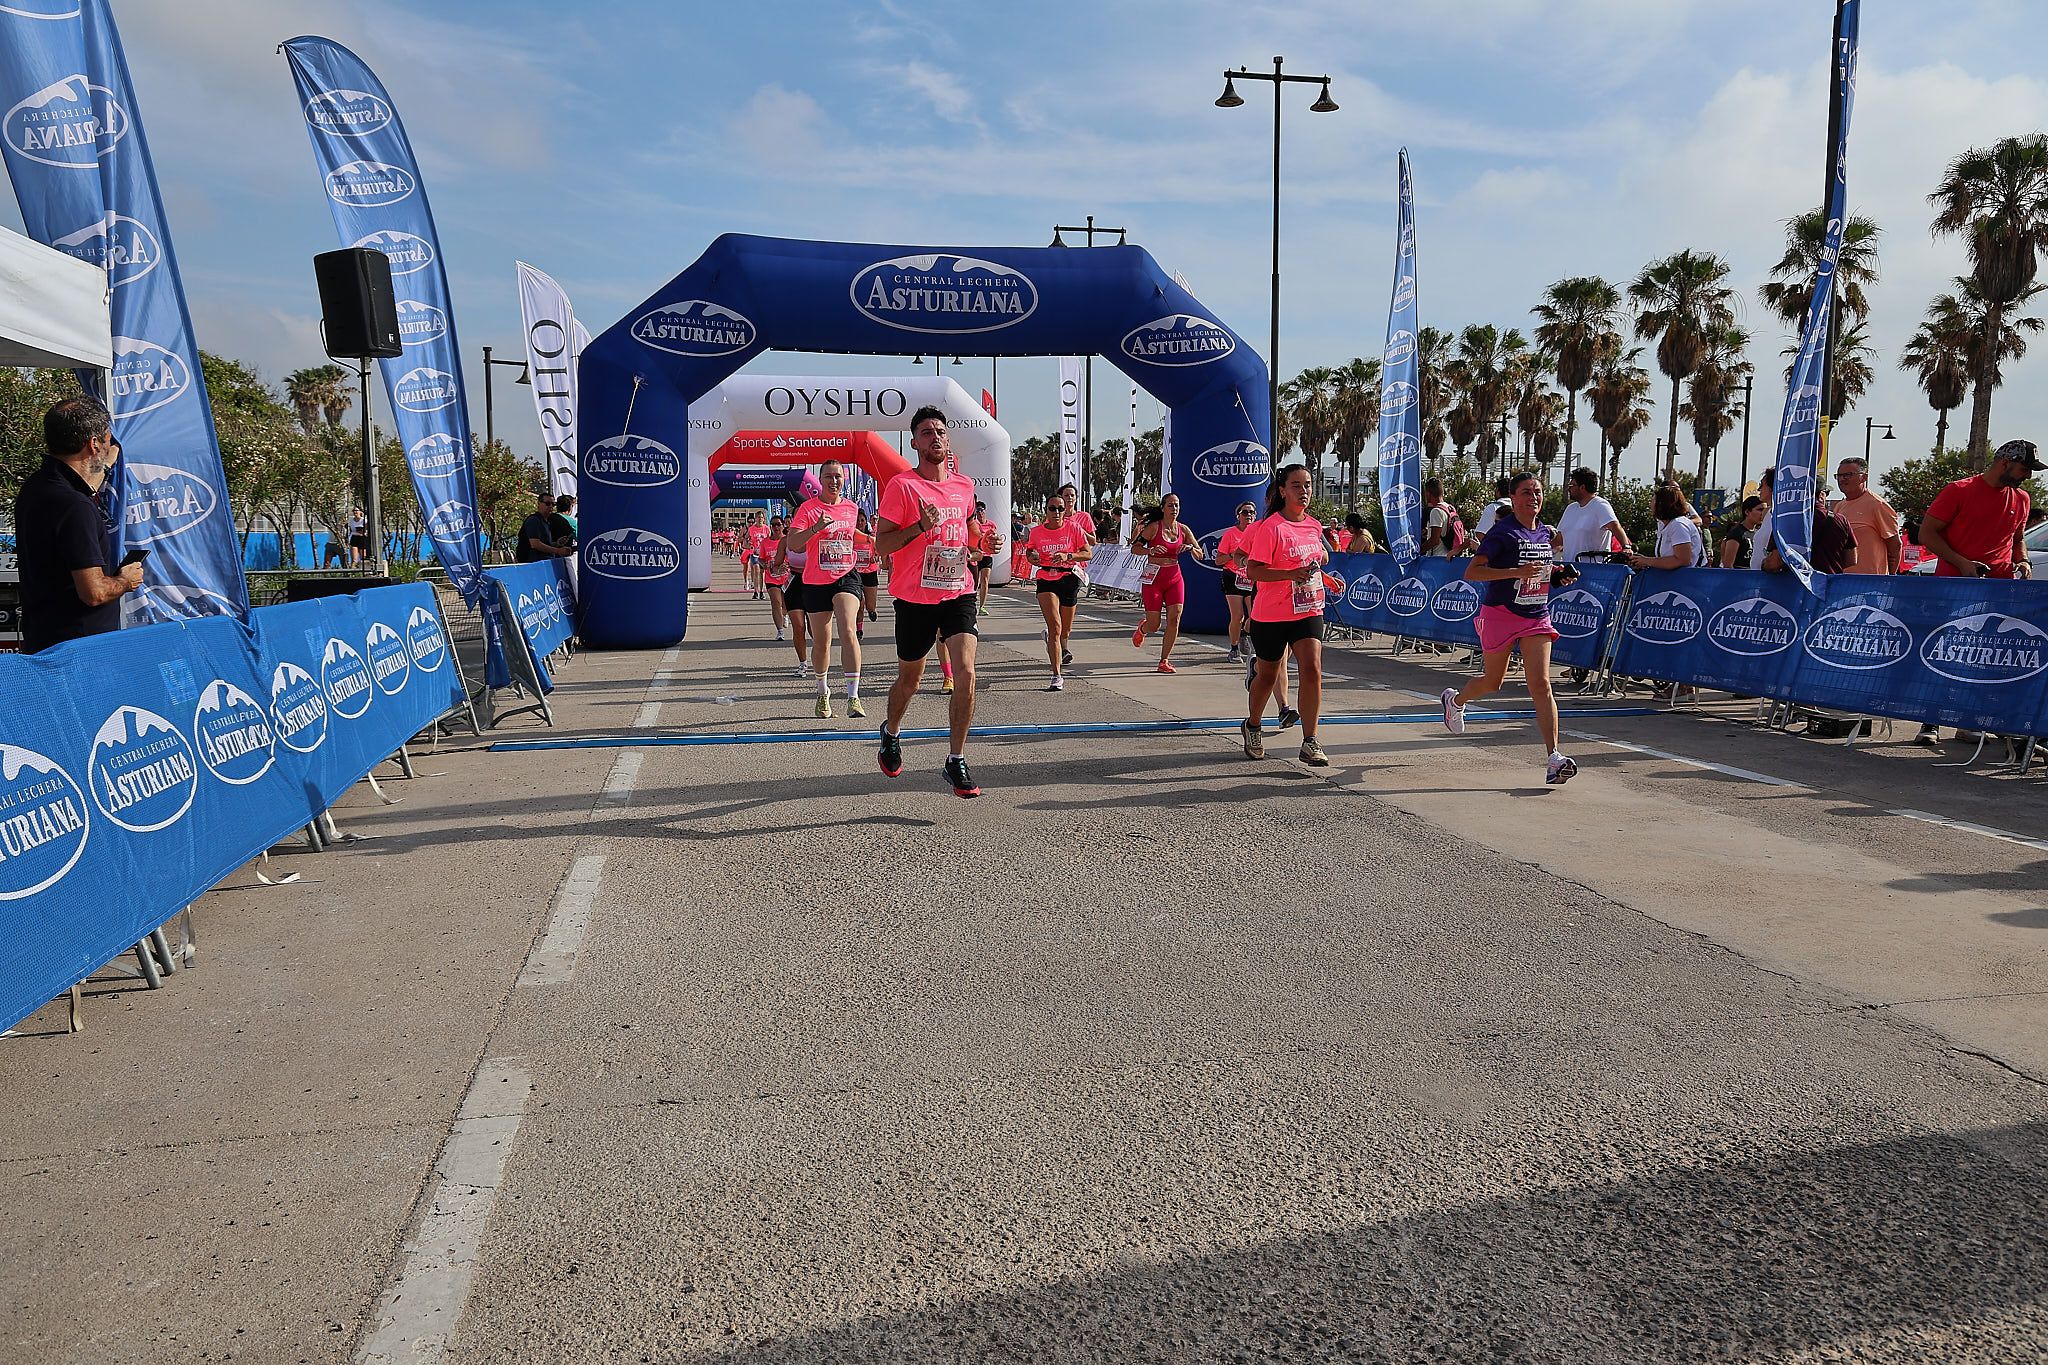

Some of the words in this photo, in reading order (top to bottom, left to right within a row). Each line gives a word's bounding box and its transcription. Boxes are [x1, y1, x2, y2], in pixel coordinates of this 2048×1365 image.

[894, 274, 953, 286] CENTRAL
[959, 277, 1018, 287] LECHERA
[864, 275, 1024, 314] ASTURIANA
[638, 318, 746, 345] ASTURIANA
[660, 317, 702, 325] CENTRAL
[705, 320, 745, 330] LECHERA
[1148, 331, 1187, 340] CENTRAL
[1190, 329, 1223, 337] LECHERA
[1130, 336, 1231, 355] ASTURIANA
[764, 387, 907, 416] OYSHO
[688, 419, 722, 430] YSHO
[947, 419, 988, 429] OYSHO
[733, 437, 771, 450] Sports
[788, 437, 848, 448] Santander
[588, 452, 675, 476] ASTURIANA
[639, 452, 673, 461] LECHERA
[588, 545, 675, 568] ASTURIANA
[639, 545, 673, 553] LECHERA
[1627, 608, 1695, 634] ASTURIANA
[1711, 615, 1788, 644] ASTURIANA
[1759, 618, 1790, 627] LECHERA
[1865, 628, 1903, 637] LECHERA
[1809, 625, 1901, 657] ASTURIANA
[1927, 635, 2040, 669] ASTURIANA
[1951, 634, 1996, 645] CENTRAL
[1997, 636, 2043, 647] LECHERA
[110, 746, 145, 769] CENTRAL
[148, 735, 179, 756] LECHERA
[17, 777, 64, 802] LECHERA
[101, 751, 194, 813] ASTURIANA
[0, 796, 84, 863] URIANA
